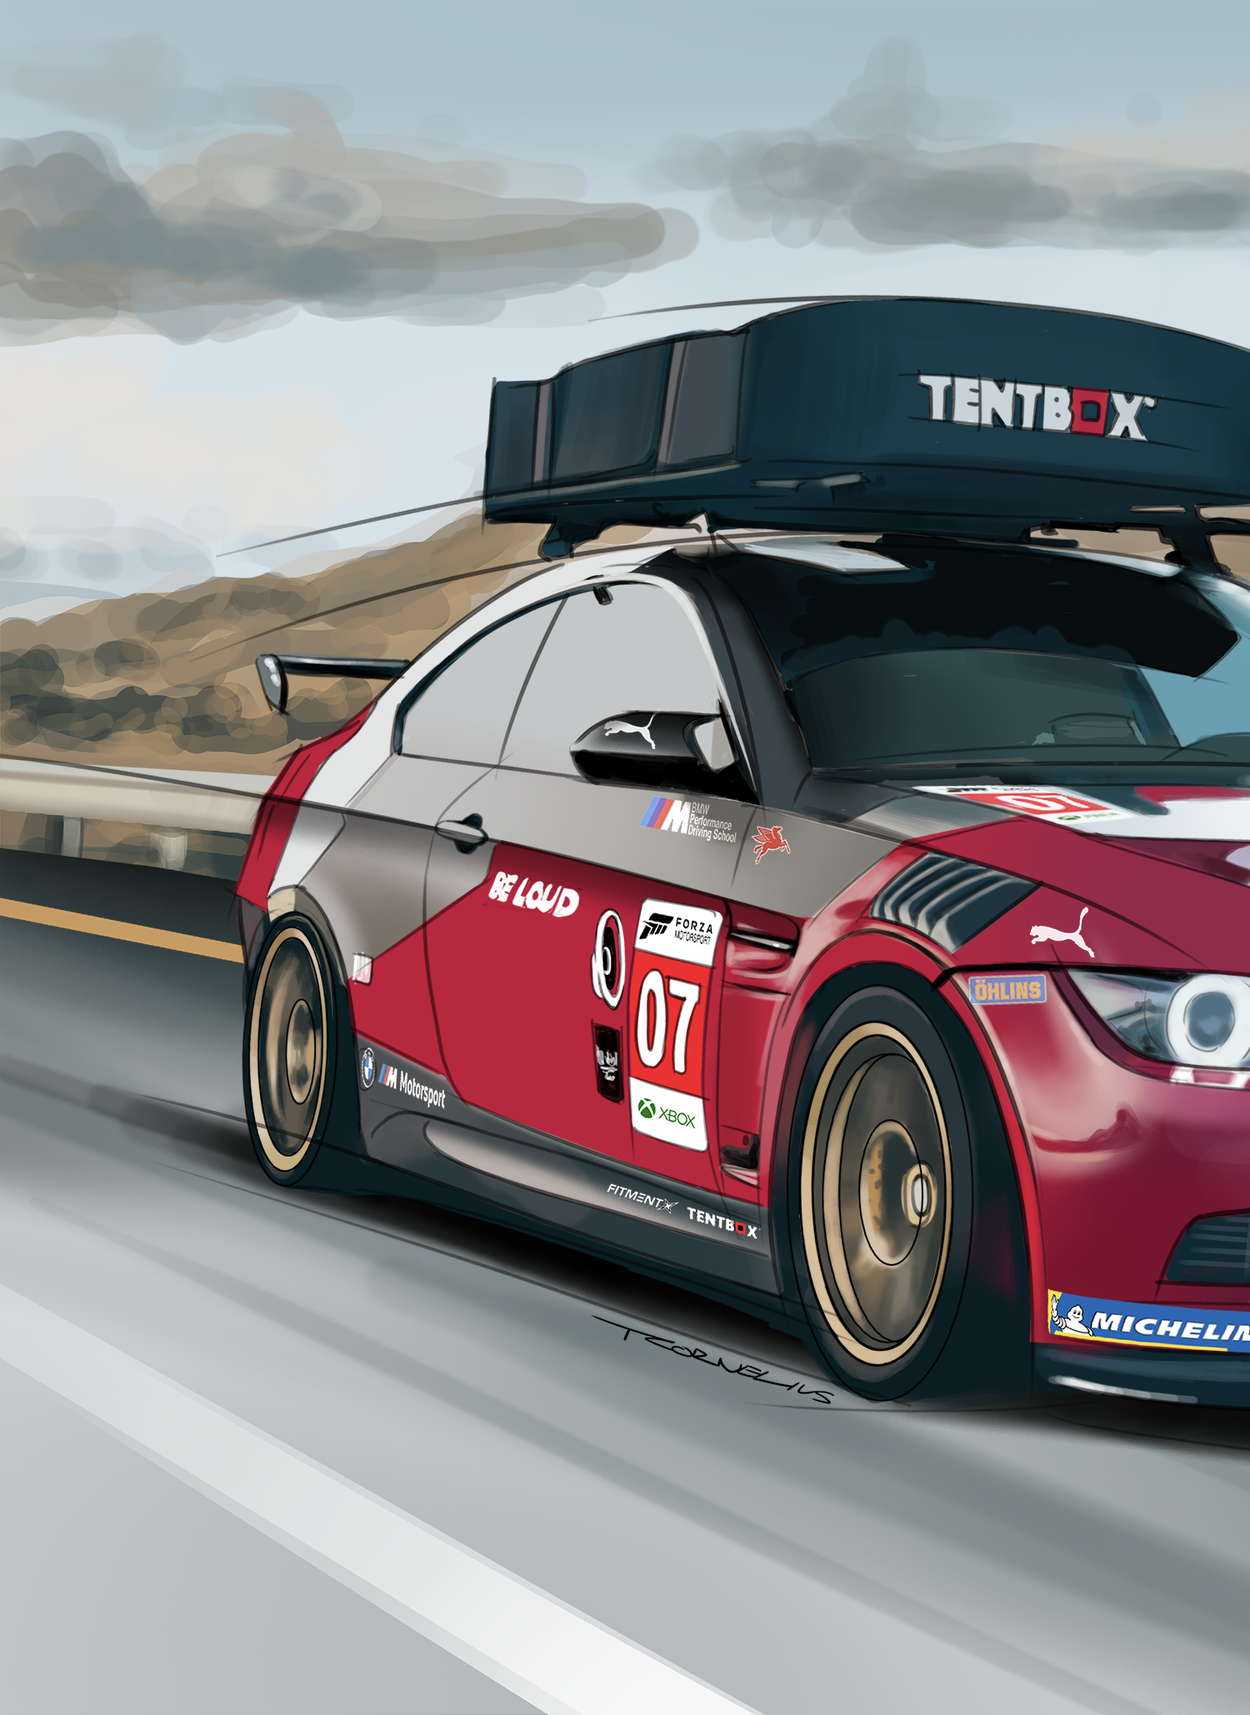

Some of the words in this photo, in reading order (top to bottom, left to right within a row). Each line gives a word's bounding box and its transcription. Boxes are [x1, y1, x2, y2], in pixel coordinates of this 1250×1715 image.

[918, 374, 1158, 442] TENTBOX
[691, 801, 710, 815] BMW
[995, 794, 1091, 811] 07
[687, 824, 712, 842] Driving
[712, 828, 737, 843] School
[689, 813, 732, 831] Performance
[488, 871, 519, 903] BE
[512, 877, 580, 918] LOUD
[674, 929, 711, 945] MOTORSPORT
[675, 917, 713, 934] FORZA
[974, 979, 1042, 1002] ÖHLINS
[636, 968, 701, 1075] 07
[399, 1070, 446, 1109] Motorsport
[658, 1106, 696, 1129] XBOX
[686, 1207, 758, 1239] TENTBOX
